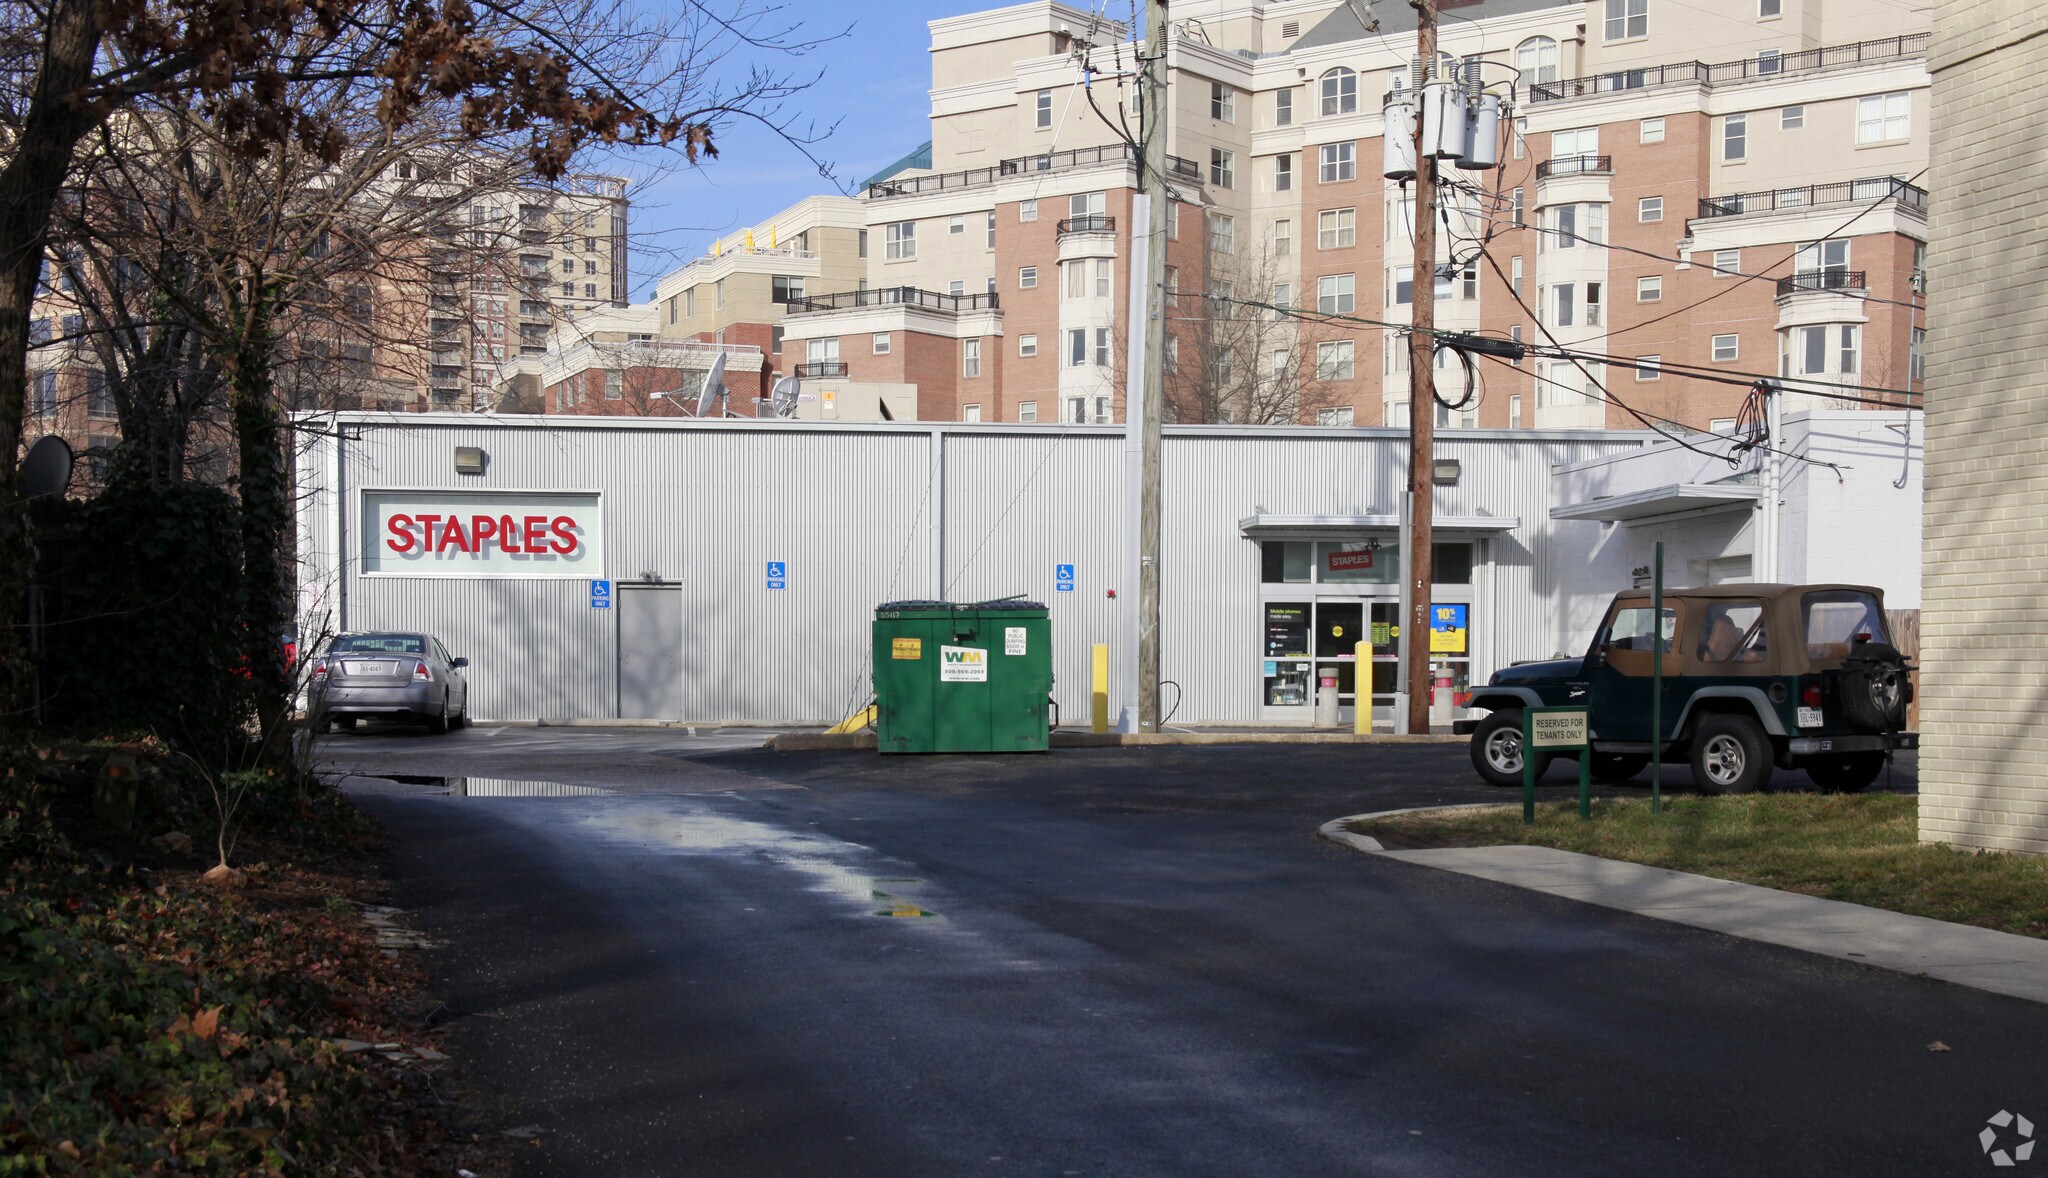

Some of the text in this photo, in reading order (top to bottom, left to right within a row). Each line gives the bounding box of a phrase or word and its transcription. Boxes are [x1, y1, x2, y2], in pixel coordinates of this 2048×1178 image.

[386, 513, 578, 554] STAPLES
[1332, 555, 1369, 566] STAPLES
[945, 652, 982, 663] WM
[1536, 718, 1584, 728] RESERVED FOR
[1536, 730, 1583, 740] TENANTS ONLY
